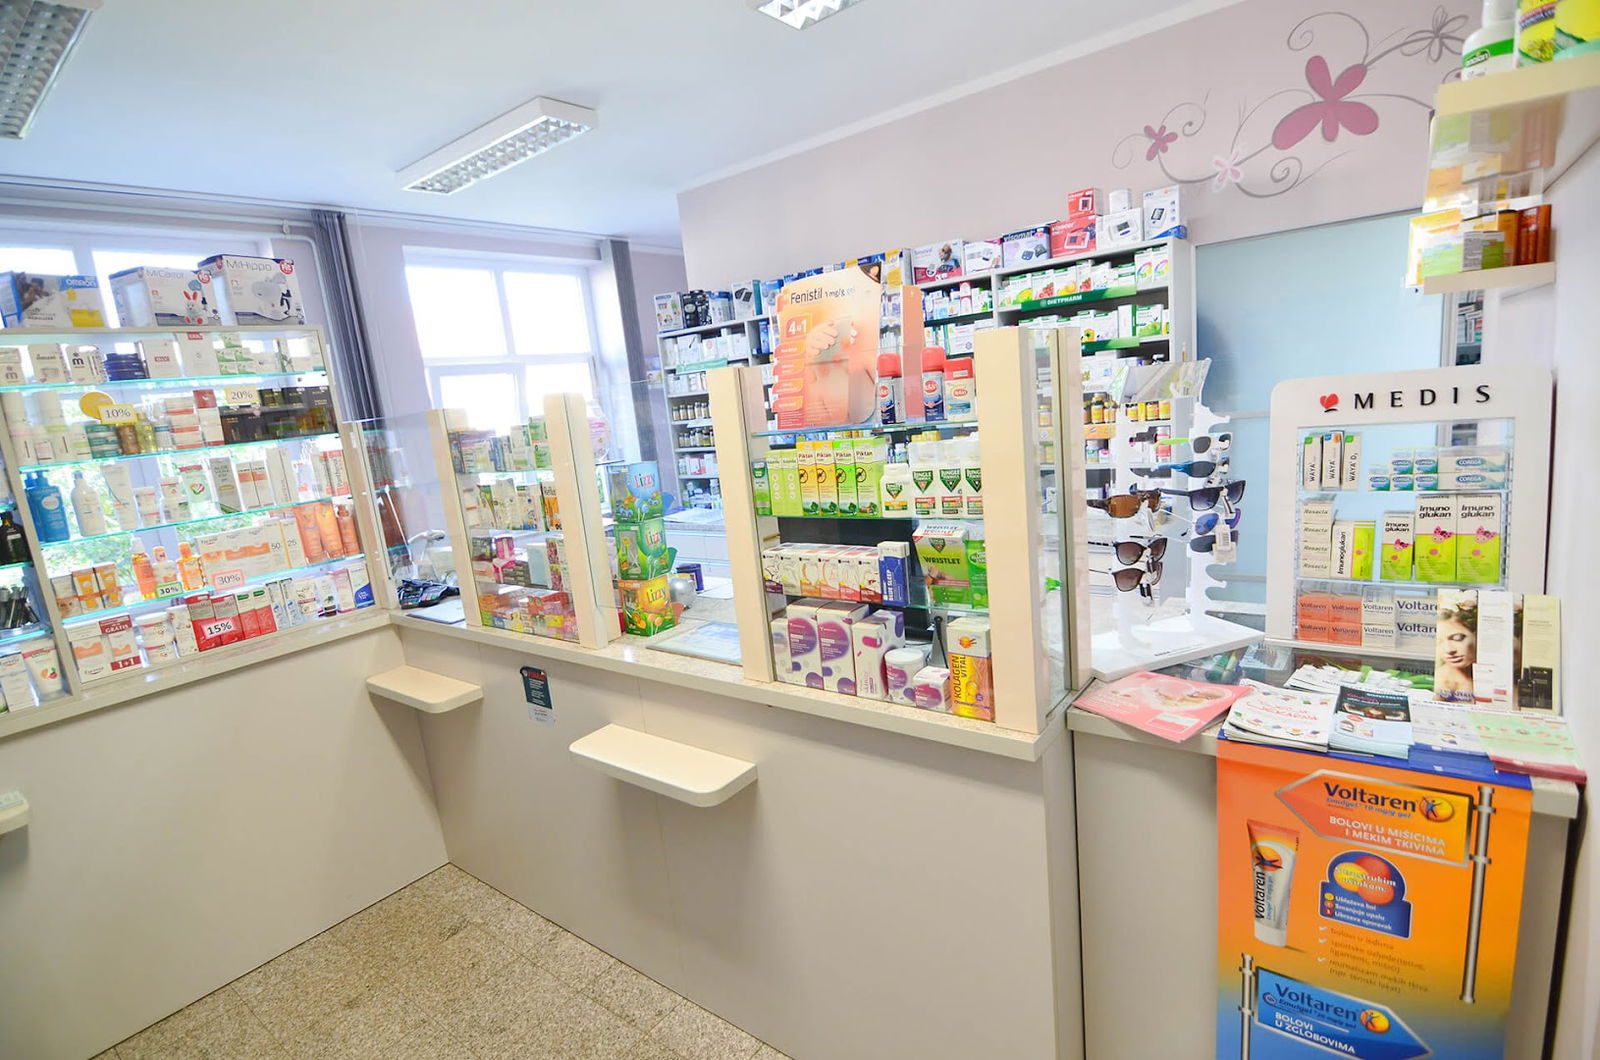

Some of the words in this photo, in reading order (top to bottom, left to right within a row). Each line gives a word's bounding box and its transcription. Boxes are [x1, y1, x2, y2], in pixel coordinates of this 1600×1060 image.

[790, 287, 823, 305] Fenistil
[231, 391, 254, 403] 20%
[1353, 384, 1491, 410] MEDIS
[105, 407, 132, 420] 10%
[634, 474, 656, 489] Lizzy
[1418, 511, 1452, 519] glukan
[1419, 504, 1451, 512] Imuno
[1460, 510, 1495, 519] glukan
[1461, 504, 1494, 512] Imuno
[646, 529, 665, 547] Lizzy
[1337, 531, 1347, 575] Imunoglukan
[923, 556, 961, 565] WRISTLET
[216, 574, 241, 586] 30%
[160, 586, 180, 595] 30%
[647, 588, 667, 603] Lizzy
[1300, 602, 1327, 610] Voltaren
[1331, 604, 1359, 612] Voltaren
[1363, 603, 1394, 612] Voltaren
[105, 623, 129, 634] GRATIS
[206, 620, 232, 635] 15%
[1363, 626, 1394, 635] Voltaren
[117, 656, 135, 669] 1+1
[960, 655, 968, 678] VITAL
[952, 655, 962, 699] KOLAGEN
[1324, 782, 1417, 812] Voltaren
[1329, 815, 1372, 831] BOLOVI
[1375, 825, 1385, 834] U
[1345, 828, 1349, 836] I
[1352, 829, 1392, 845] MEKIM
[1395, 838, 1445, 856] TKIVIMA
[1254, 871, 1266, 920] Voltaren
[1335, 904, 1365, 916] Smanjuje
[1362, 918, 1392, 931] oporavak
[1275, 983, 1357, 1021] Voltaren
[1278, 999, 1313, 1014] Emulgel
[1275, 1011, 1314, 1031] BOLOVI
[1275, 1020, 1283, 1028] U
[1285, 1023, 1356, 1054] ZGLOBOVIMA
